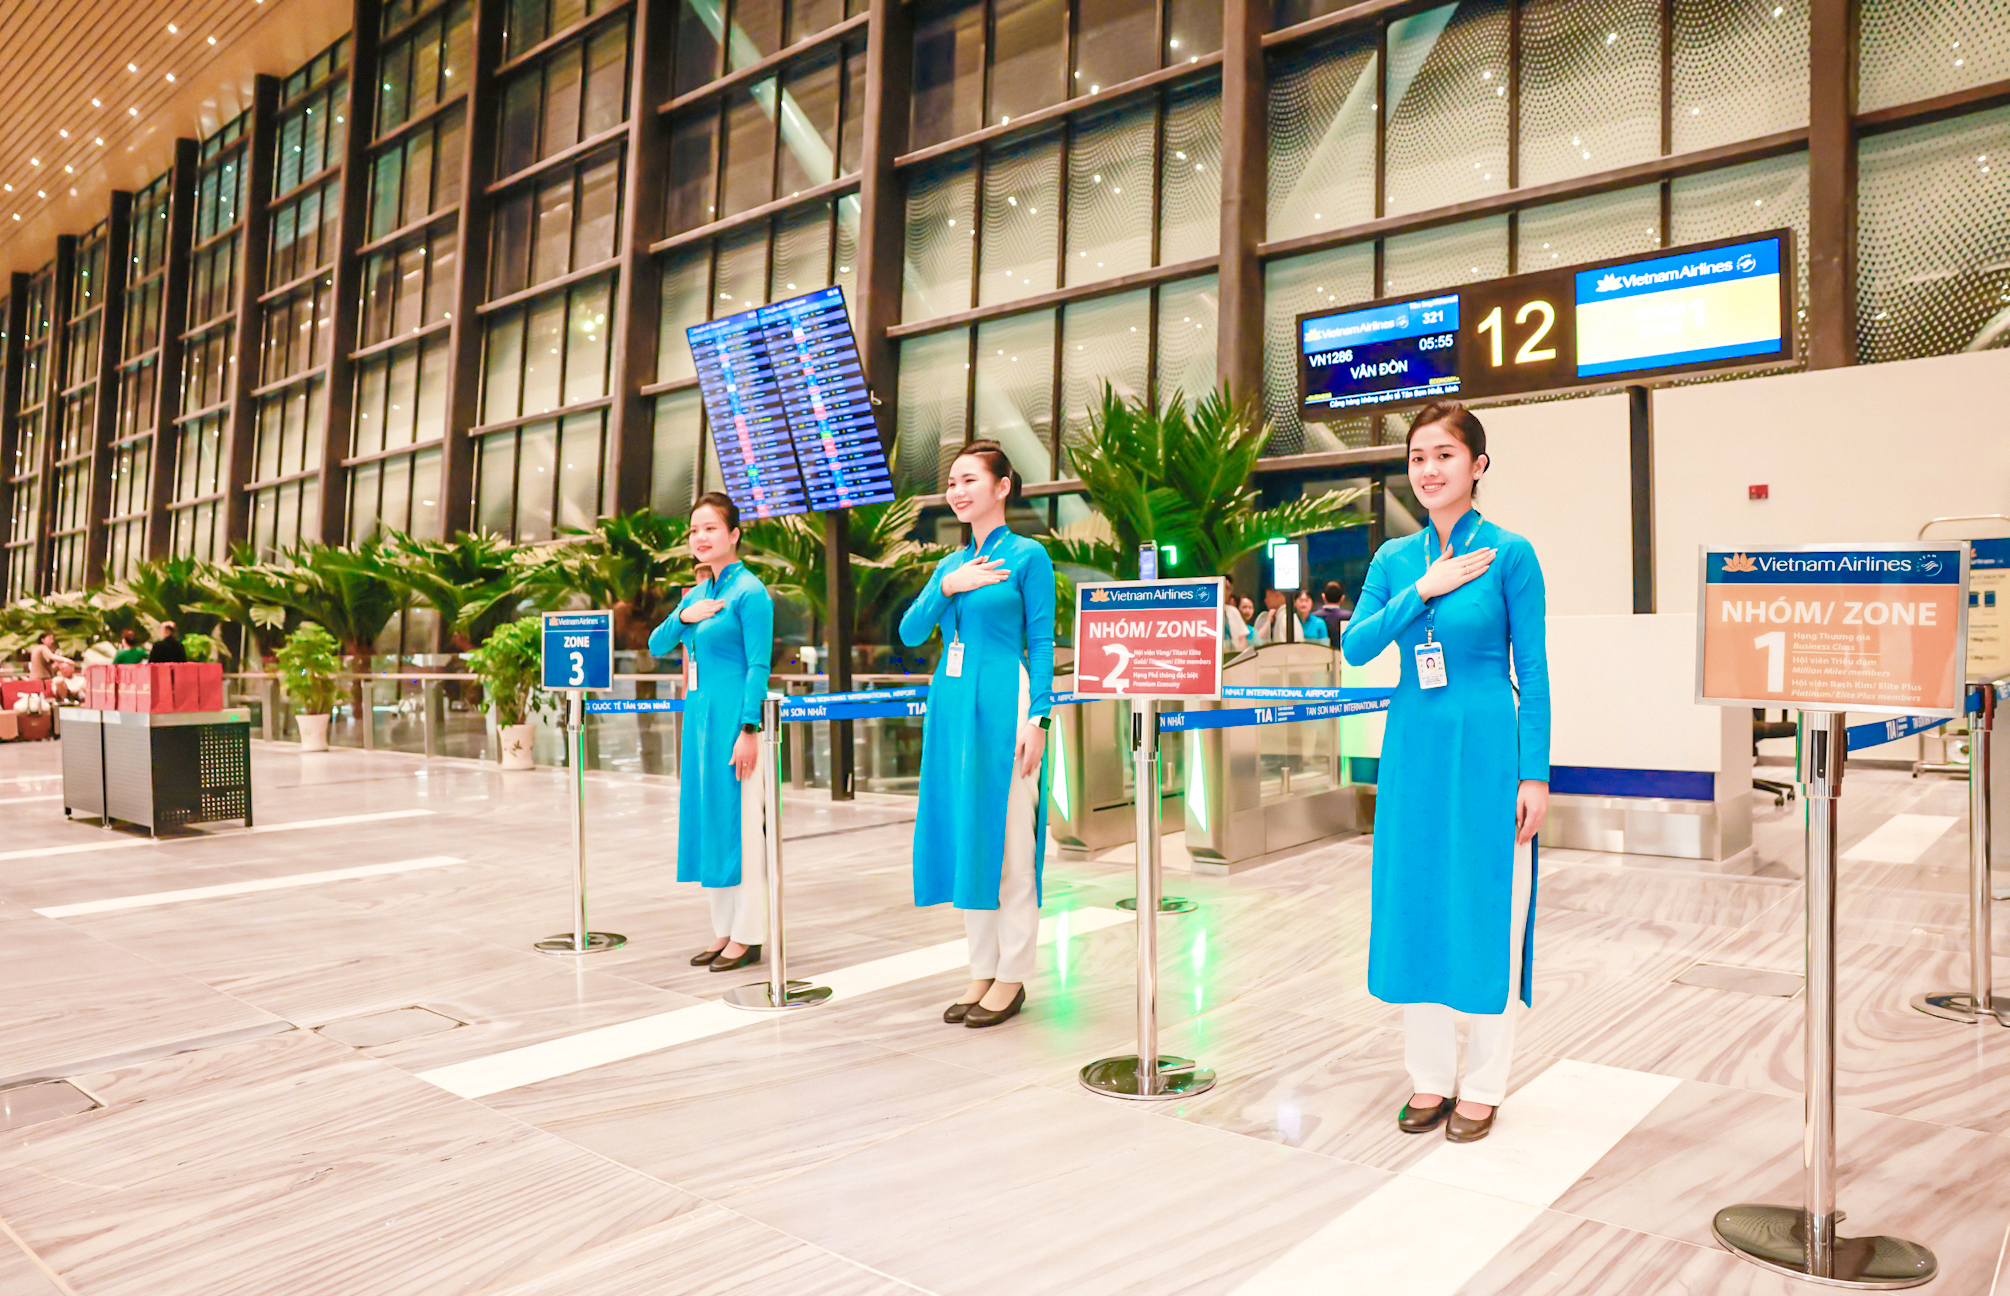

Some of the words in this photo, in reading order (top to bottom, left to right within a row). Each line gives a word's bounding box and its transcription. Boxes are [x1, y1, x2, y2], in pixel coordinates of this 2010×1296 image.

[1622, 271, 1679, 289] Vietnam
[1680, 259, 1733, 279] Airlines
[1422, 310, 1443, 324] 321
[1321, 325, 1360, 339] Vietnam
[1360, 320, 1394, 333] Airlines
[1477, 300, 1556, 367] 12
[1419, 334, 1454, 351] 05:55
[1309, 350, 1353, 367] VN1286
[1758, 556, 1835, 572] Vietnam
[1837, 556, 1911, 571] Airlines
[1110, 590, 1153, 601] Vietnam
[1154, 589, 1193, 600] Airlines
[1722, 596, 1835, 625] NHÓM/
[1843, 602, 1937, 626] ZONE
[580, 617, 598, 625] Airlines
[1089, 618, 1153, 638] NHÓM/
[1155, 620, 1207, 637] ZONE
[564, 636, 590, 648] ZONE
[1793, 632, 1817, 641] Hạng
[1820, 632, 1854, 642] Thương
[1856, 633, 1871, 642] gia
[1133, 649, 1143, 657] Hội
[1832, 643, 1855, 651] Class
[1102, 643, 1130, 688] 2
[1754, 631, 1785, 692] 1
[1792, 656, 1807, 666] Hội
[1810, 656, 1829, 664] viên
[1831, 657, 1854, 667] Triệu
[569, 651, 585, 686] 3
[1848, 669, 1890, 677] members
[1133, 671, 1147, 680] Hạng
[1159, 671, 1175, 680] thông
[1187, 671, 1198, 680] biệt
[1157, 680, 1180, 689] Economy
[1792, 679, 1807, 688] Hội
[1830, 681, 1852, 690] Bạch
[1855, 681, 1876, 689] Kim/
[1879, 682, 1900, 690] Elite
[1902, 683, 1922, 691] Plus
[893, 689, 916, 697] AIRPORT
[1225, 688, 1245, 696] NHAT
[1246, 688, 1303, 697] INTERNATIONAL
[1305, 689, 1340, 698] AIRPORT
[1791, 689, 1834, 698] Platinum/
[1857, 692, 1876, 700] Plus
[1878, 693, 1921, 701] members
[622, 701, 636, 710] TÂN
[637, 701, 651, 710] SƠN
[790, 707, 806, 717] SƠN
[808, 705, 827, 717] NHẤT
[907, 703, 927, 715] TIA
[1306, 706, 1316, 716] TAN
[1317, 705, 1328, 715] SON
[1329, 704, 1342, 714] NHAT
[1344, 701, 1379, 712] INTERNATIONAL
[1167, 713, 1185, 726] NHẤT
[1255, 708, 1273, 723] TIA
